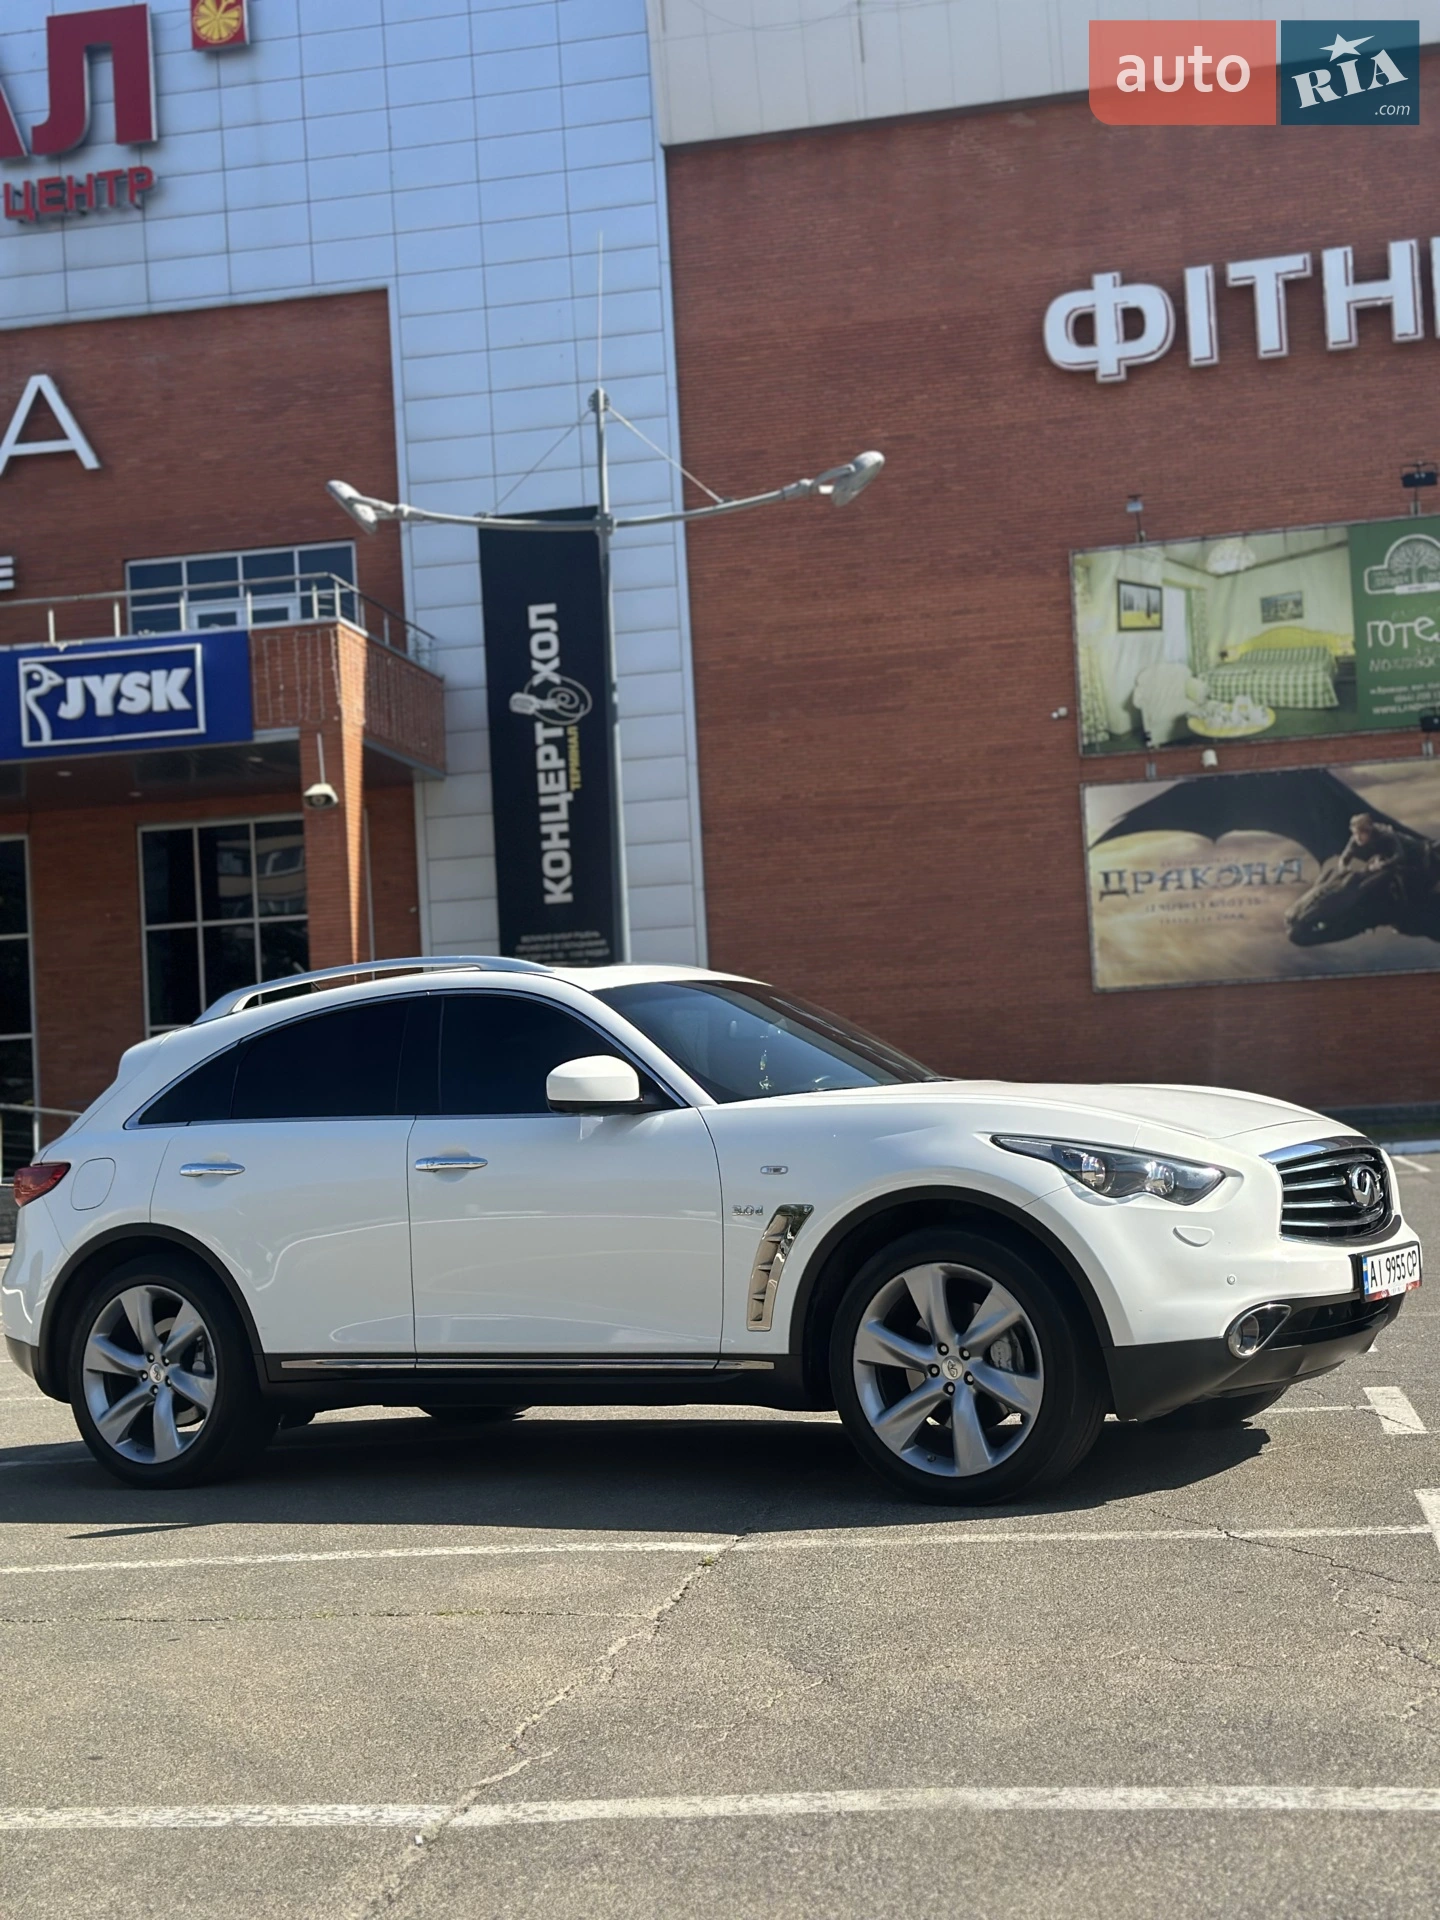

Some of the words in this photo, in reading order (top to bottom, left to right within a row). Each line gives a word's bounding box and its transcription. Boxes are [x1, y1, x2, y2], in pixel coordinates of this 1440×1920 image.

[0, 3, 157, 160] Л
[3, 166, 154, 222] ЦЕНТР
[527, 603, 561, 686] ХОЛ
[57, 667, 192, 720] JYSK
[534, 721, 574, 904] КОНЦЕРТ
[1098, 857, 1307, 901] ДРАКОНА
[1370, 1259, 1383, 1288] AI
[1385, 1253, 1406, 1284] 9955
[1406, 1250, 1418, 1277] CP
